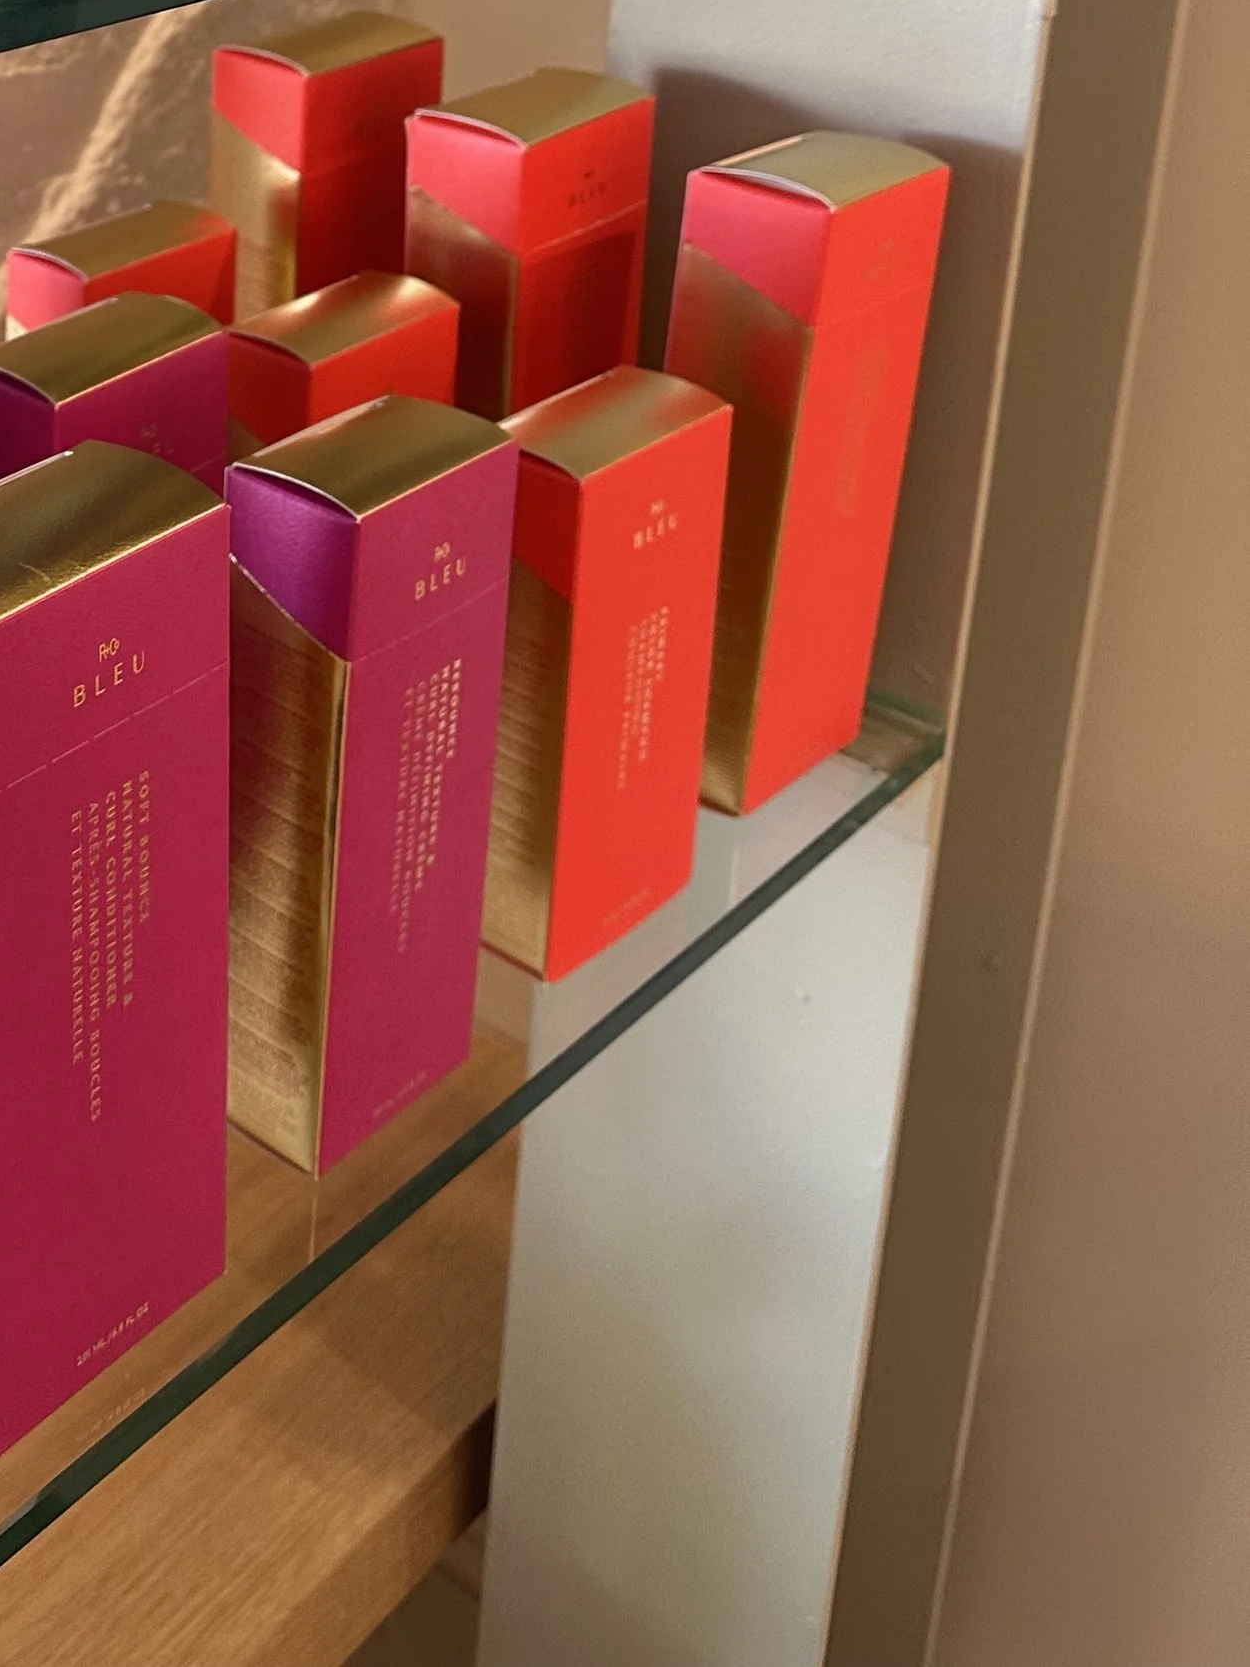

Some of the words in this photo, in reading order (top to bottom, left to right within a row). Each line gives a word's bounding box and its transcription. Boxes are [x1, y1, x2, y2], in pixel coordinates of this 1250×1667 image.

[414, 556, 468, 601] BLEU
[73, 650, 145, 708] BLEU
[70, 807, 82, 837] ET
[105, 787, 117, 849] CURL
[121, 778, 133, 883] NATURAL
[138, 767, 150, 828] SOFT
[70, 842, 83, 941] TEXTURE
[138, 832, 150, 924] BOUNCE
[105, 854, 117, 1010] CONDITIONER
[121, 887, 133, 987] TEXTURE
[71, 945, 84, 1065] NATURELLE
[88, 1027, 101, 1123] BOUCLES
